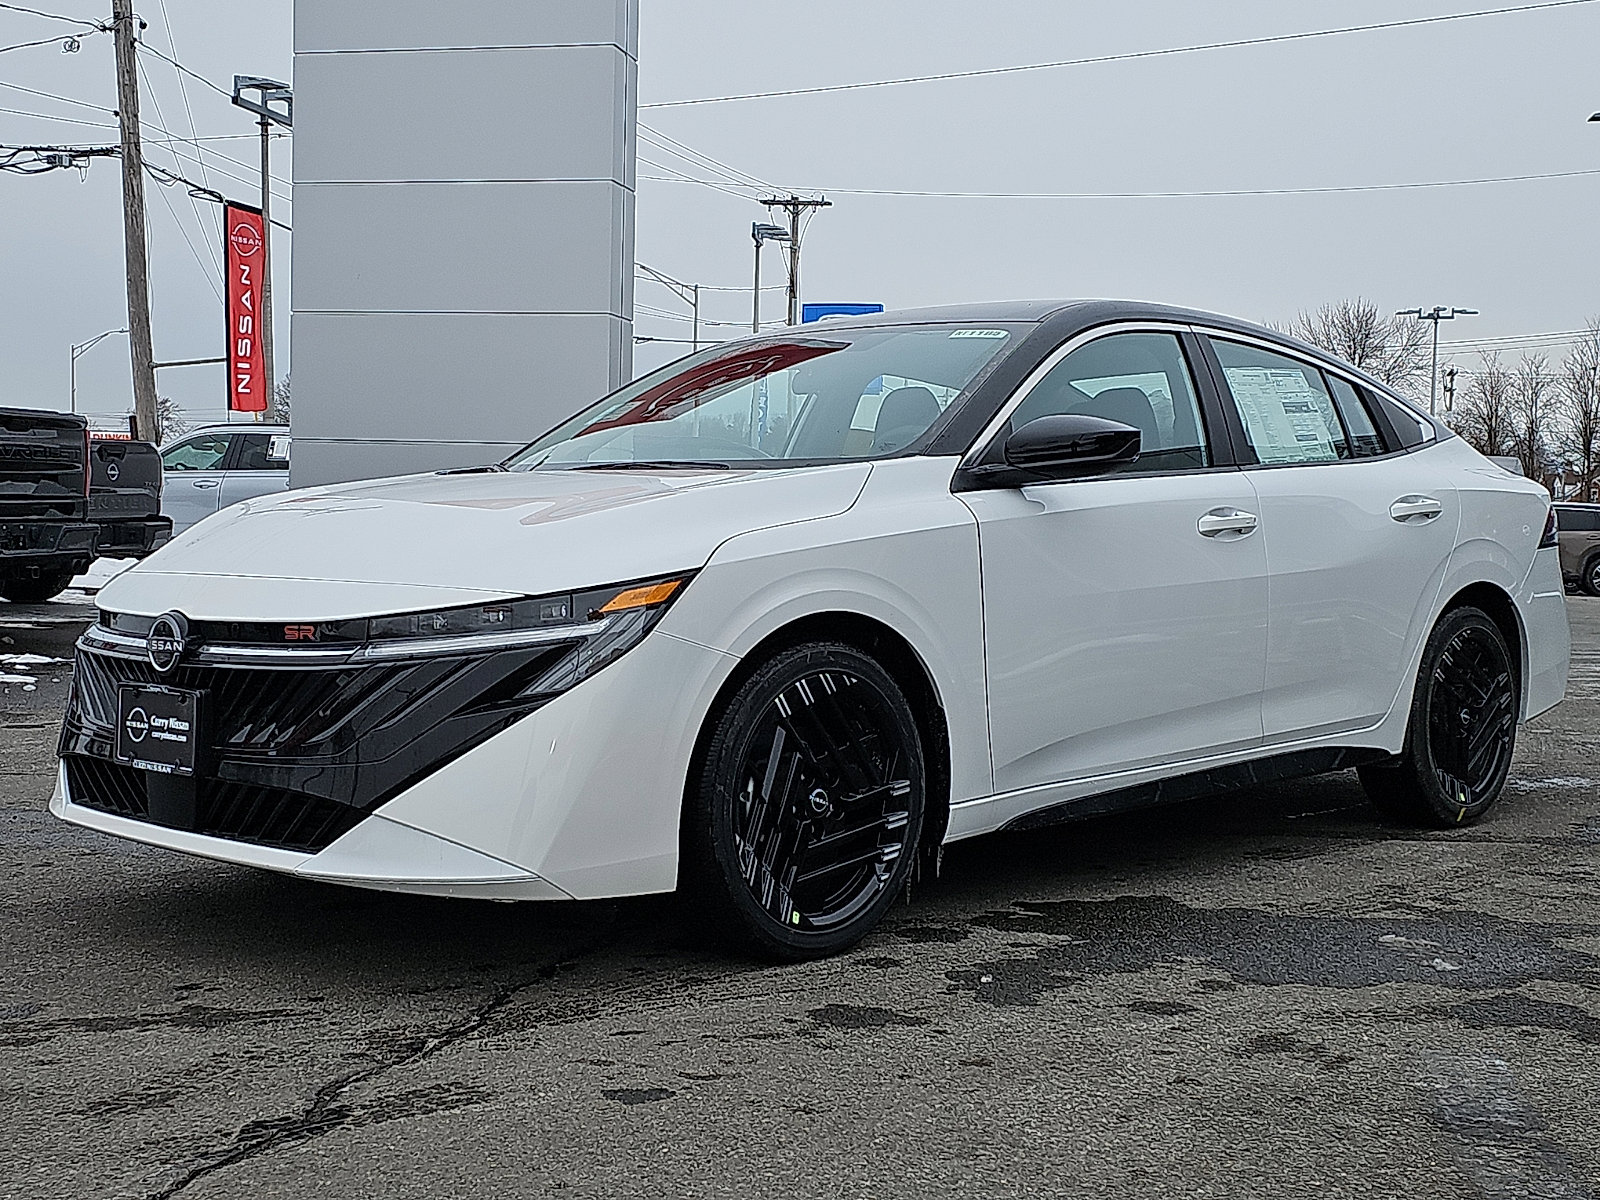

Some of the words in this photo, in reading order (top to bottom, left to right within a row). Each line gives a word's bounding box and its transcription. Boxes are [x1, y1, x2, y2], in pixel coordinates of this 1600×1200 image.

[231, 234, 262, 246] NISSAN
[237, 264, 253, 394] NISSAN
[284, 625, 315, 641] SR
[125, 720, 149, 730] NISSAN
[150, 714, 169, 730] Curry
[169, 717, 190, 731] Nissan
